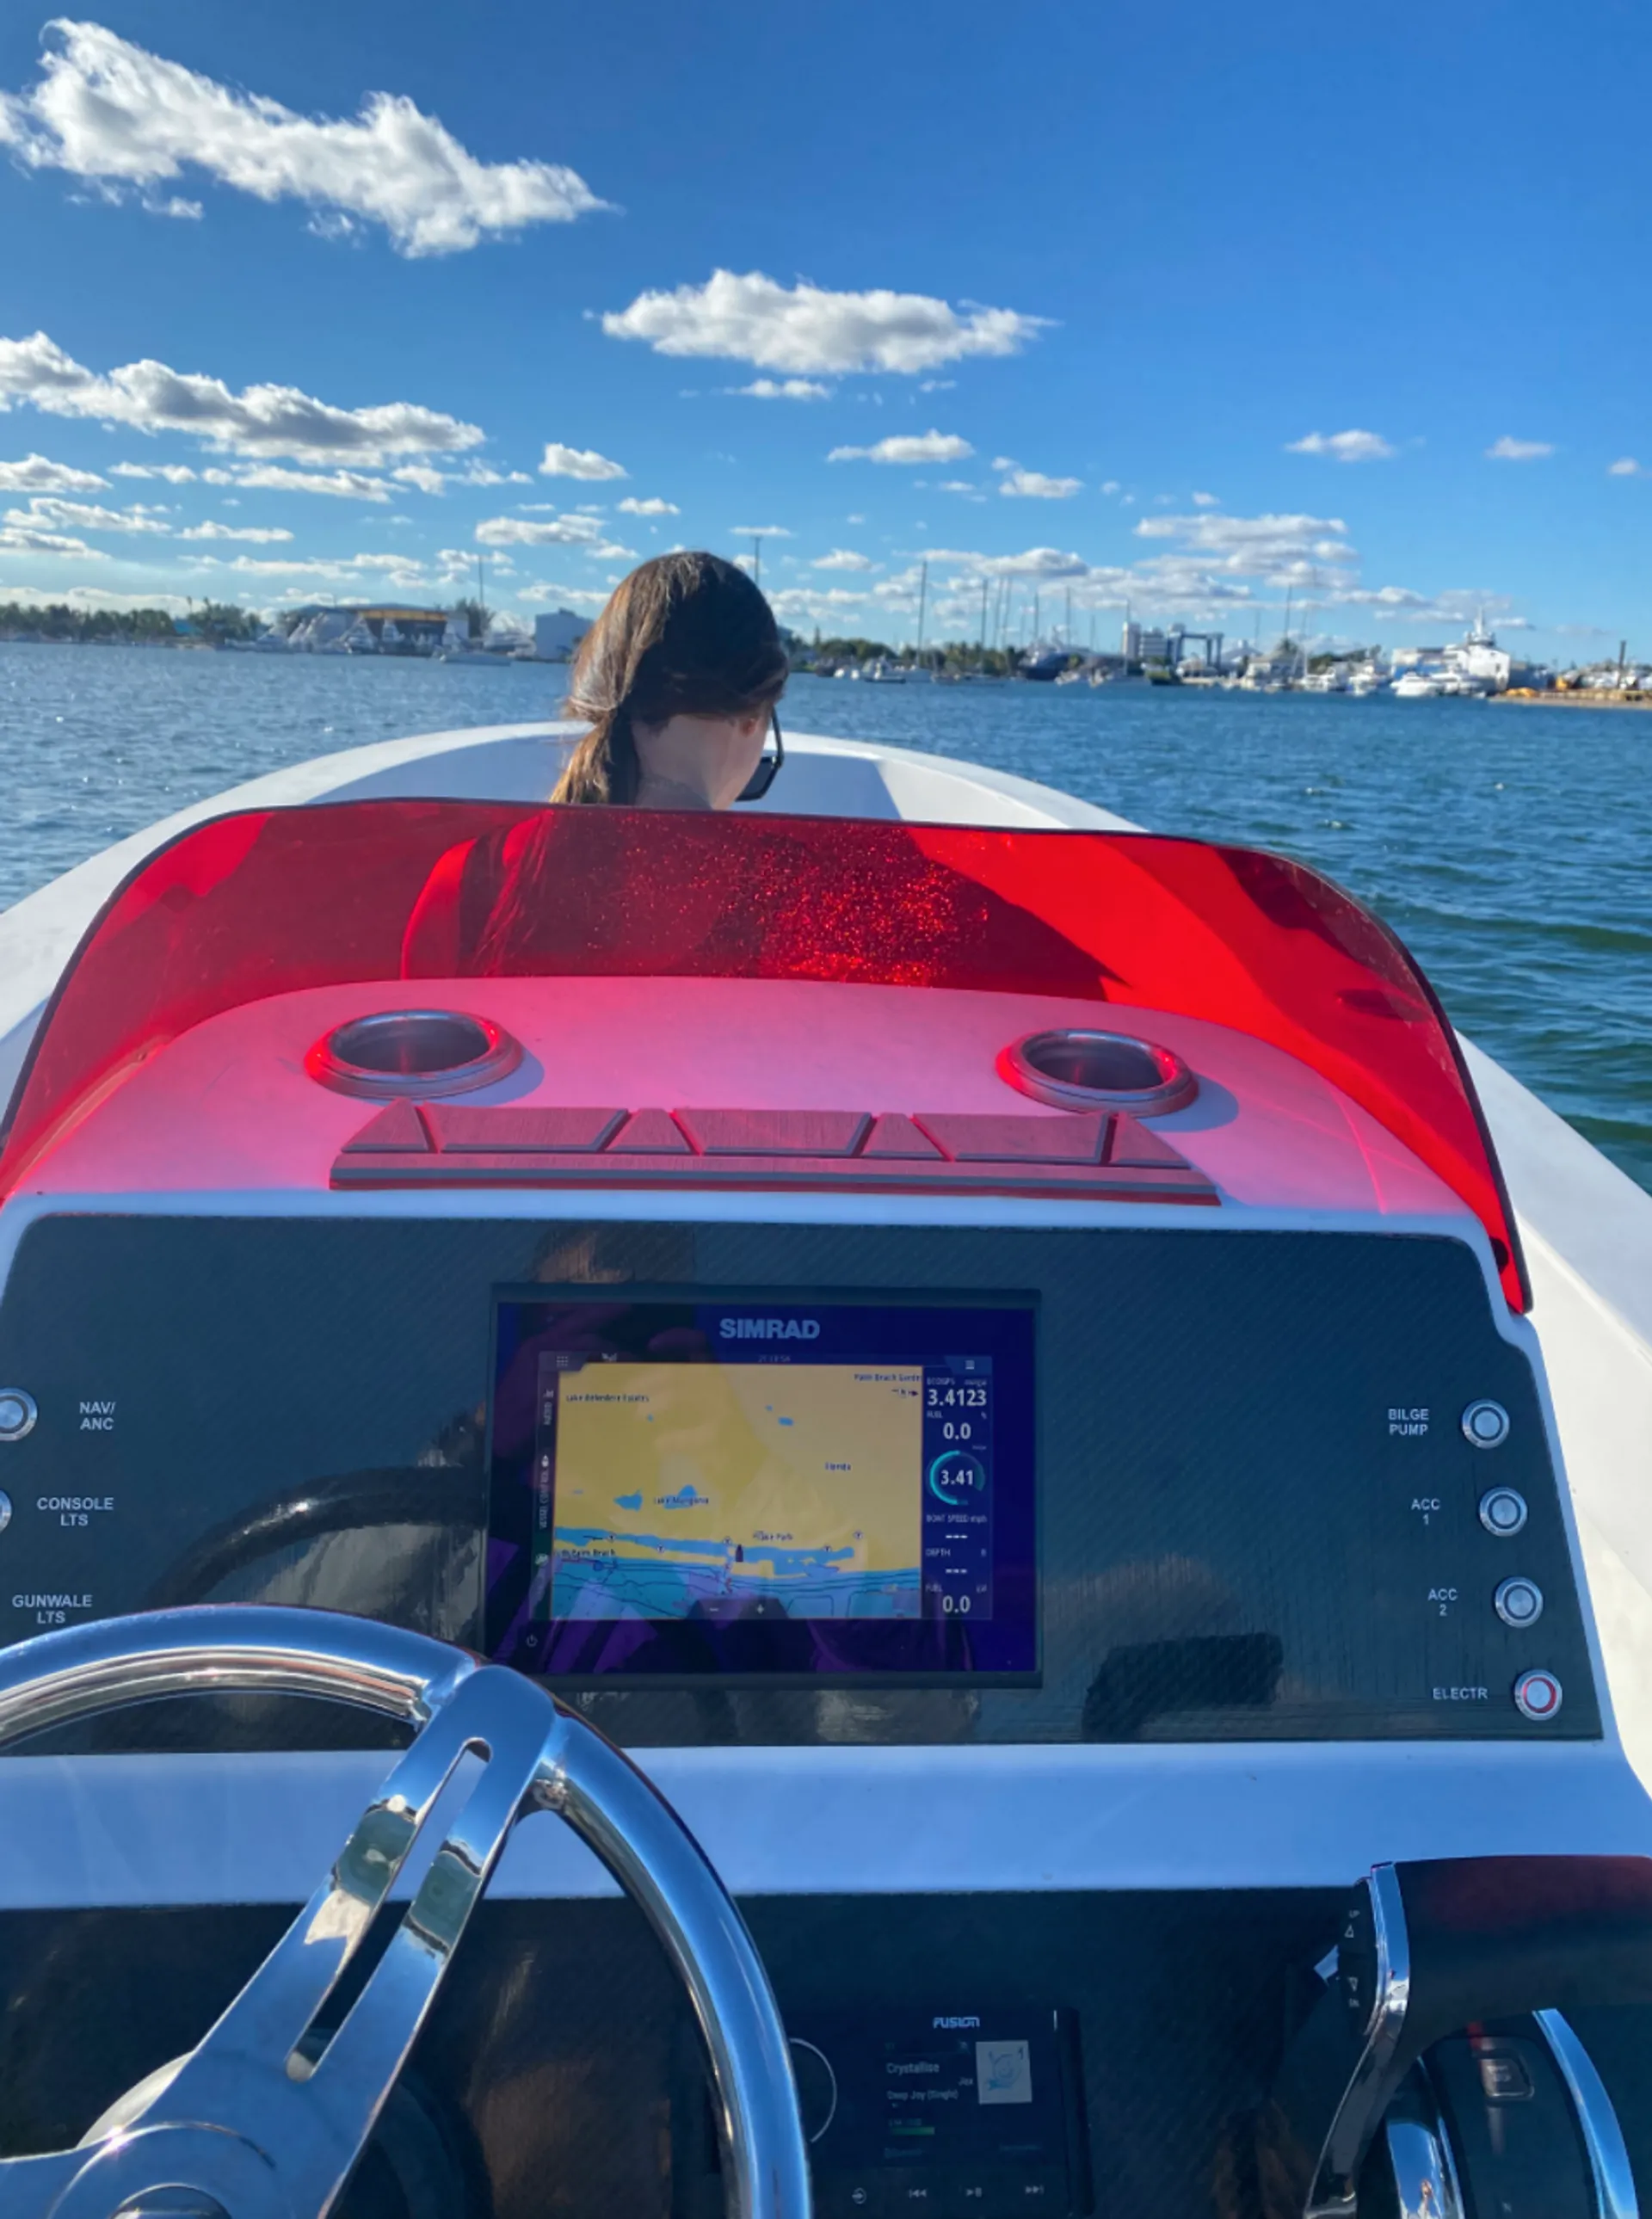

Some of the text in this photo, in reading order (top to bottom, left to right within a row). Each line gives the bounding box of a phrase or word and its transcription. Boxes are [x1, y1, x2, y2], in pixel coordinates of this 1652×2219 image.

[719, 1318, 820, 1339] SIMRAD
[927, 1389, 987, 1407] 3.4123
[79, 1401, 116, 1415] NAV/
[1388, 1408, 1429, 1421] BILGE
[79, 1416, 114, 1430] ANC
[1389, 1423, 1428, 1435] PUMP
[943, 1422, 971, 1440] 0.0
[940, 1470, 973, 1485] 3.41
[36, 1496, 114, 1511] CONSOLE
[1411, 1498, 1440, 1511] ACC
[60, 1513, 89, 1526] LTS
[1422, 1513, 1430, 1526] 1
[1427, 1588, 1458, 1600] ACC
[12, 1594, 93, 1608] GUNWALE
[943, 1595, 971, 1613] 0.0
[1439, 1604, 1447, 1617] 2
[37, 1611, 65, 1624] LTS
[1433, 1687, 1488, 1700] ELECTR
